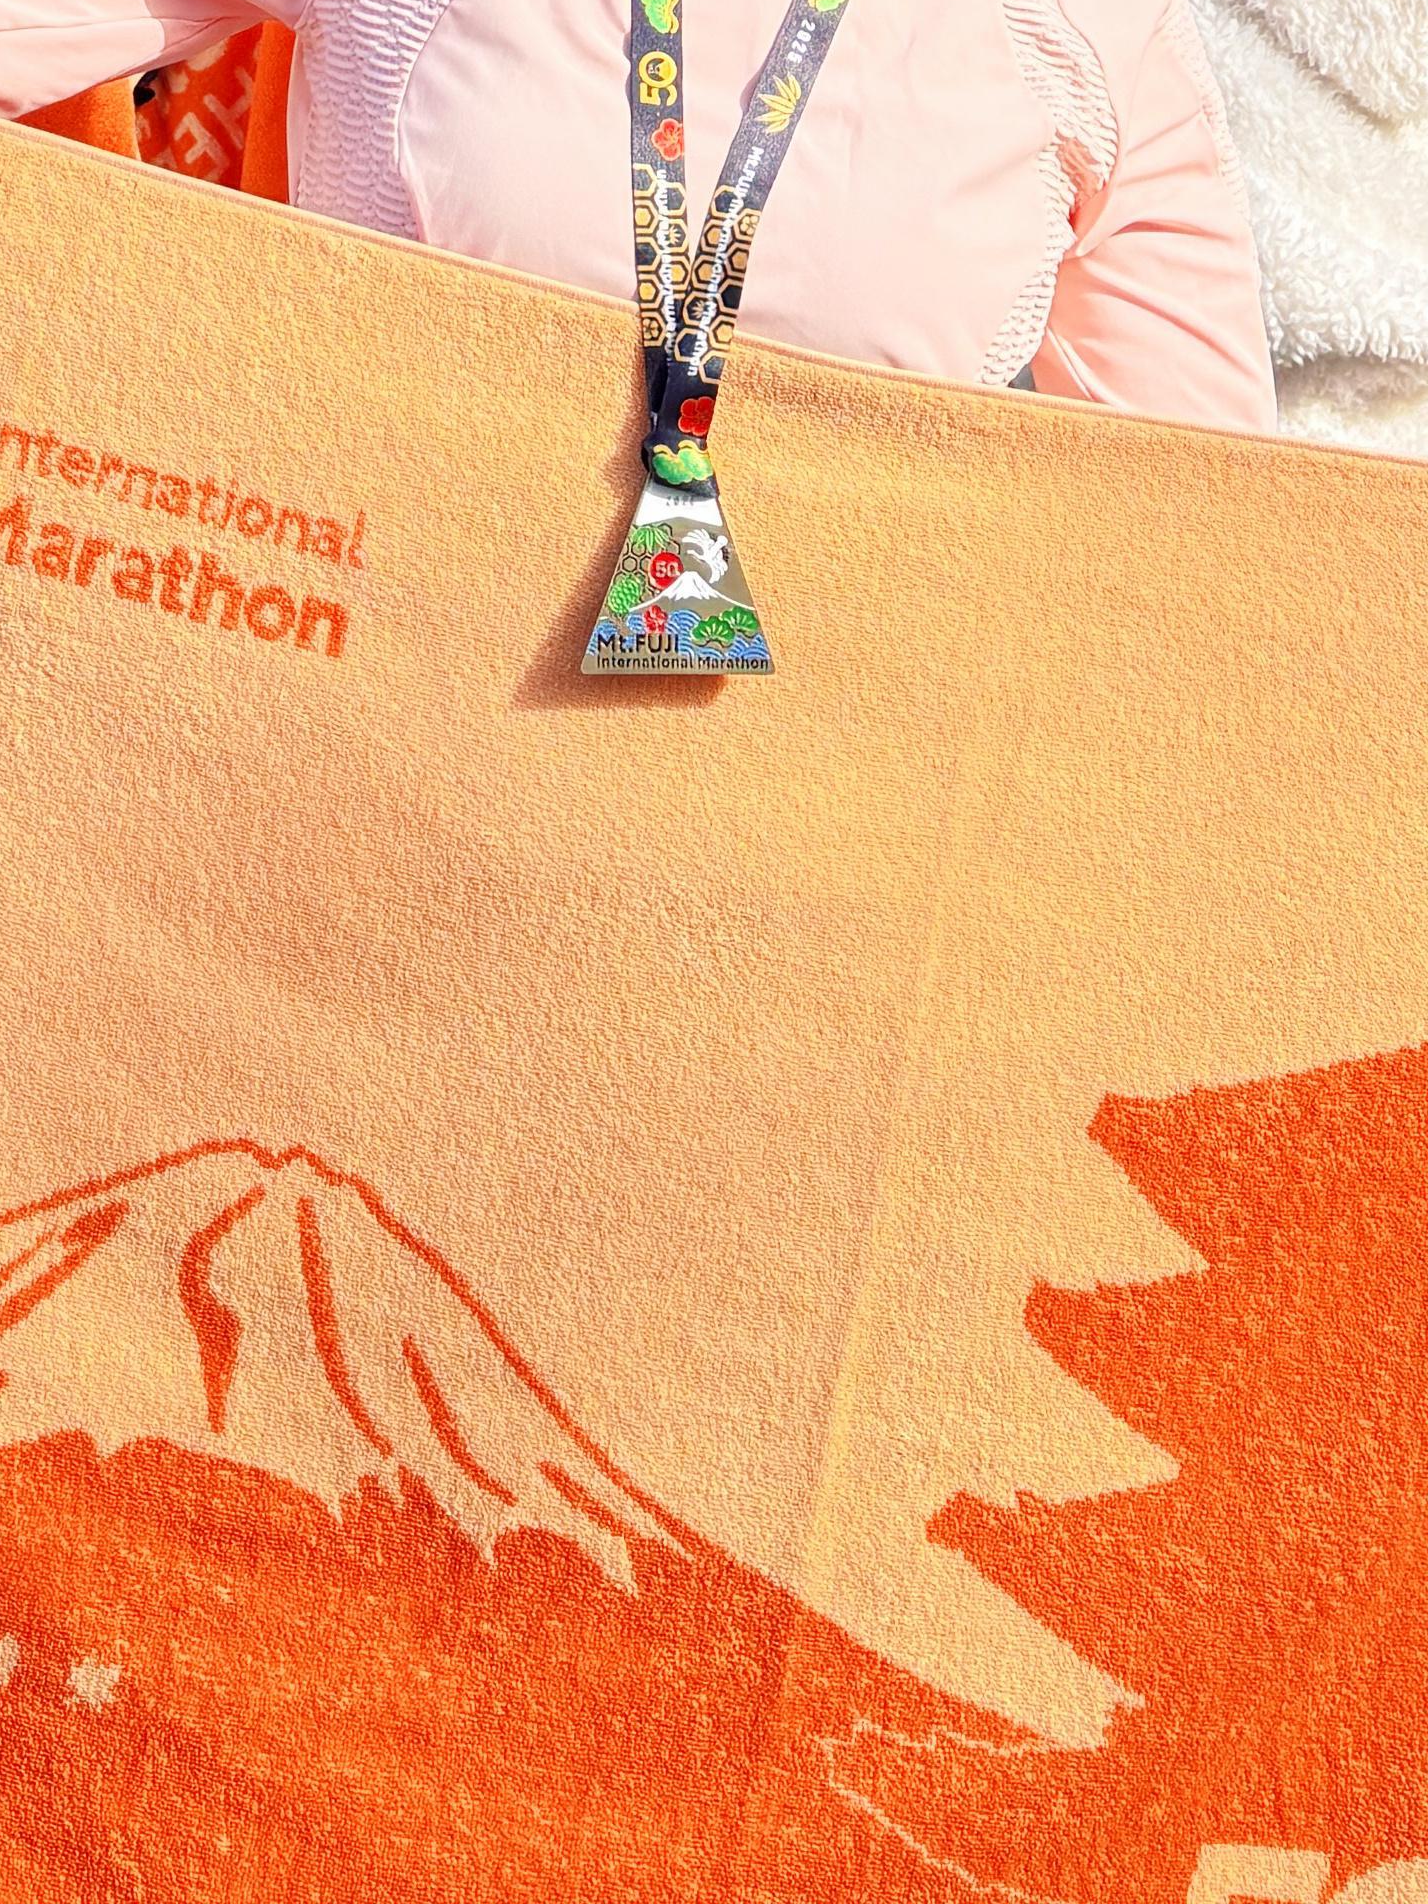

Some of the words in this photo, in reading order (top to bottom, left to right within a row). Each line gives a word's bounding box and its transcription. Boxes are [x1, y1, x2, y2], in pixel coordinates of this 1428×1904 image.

[788, 19, 815, 64] 2025
[597, 635, 679, 655] Mt.FUJI
[597, 655, 693, 669] International
[699, 656, 768, 671] Marathon
